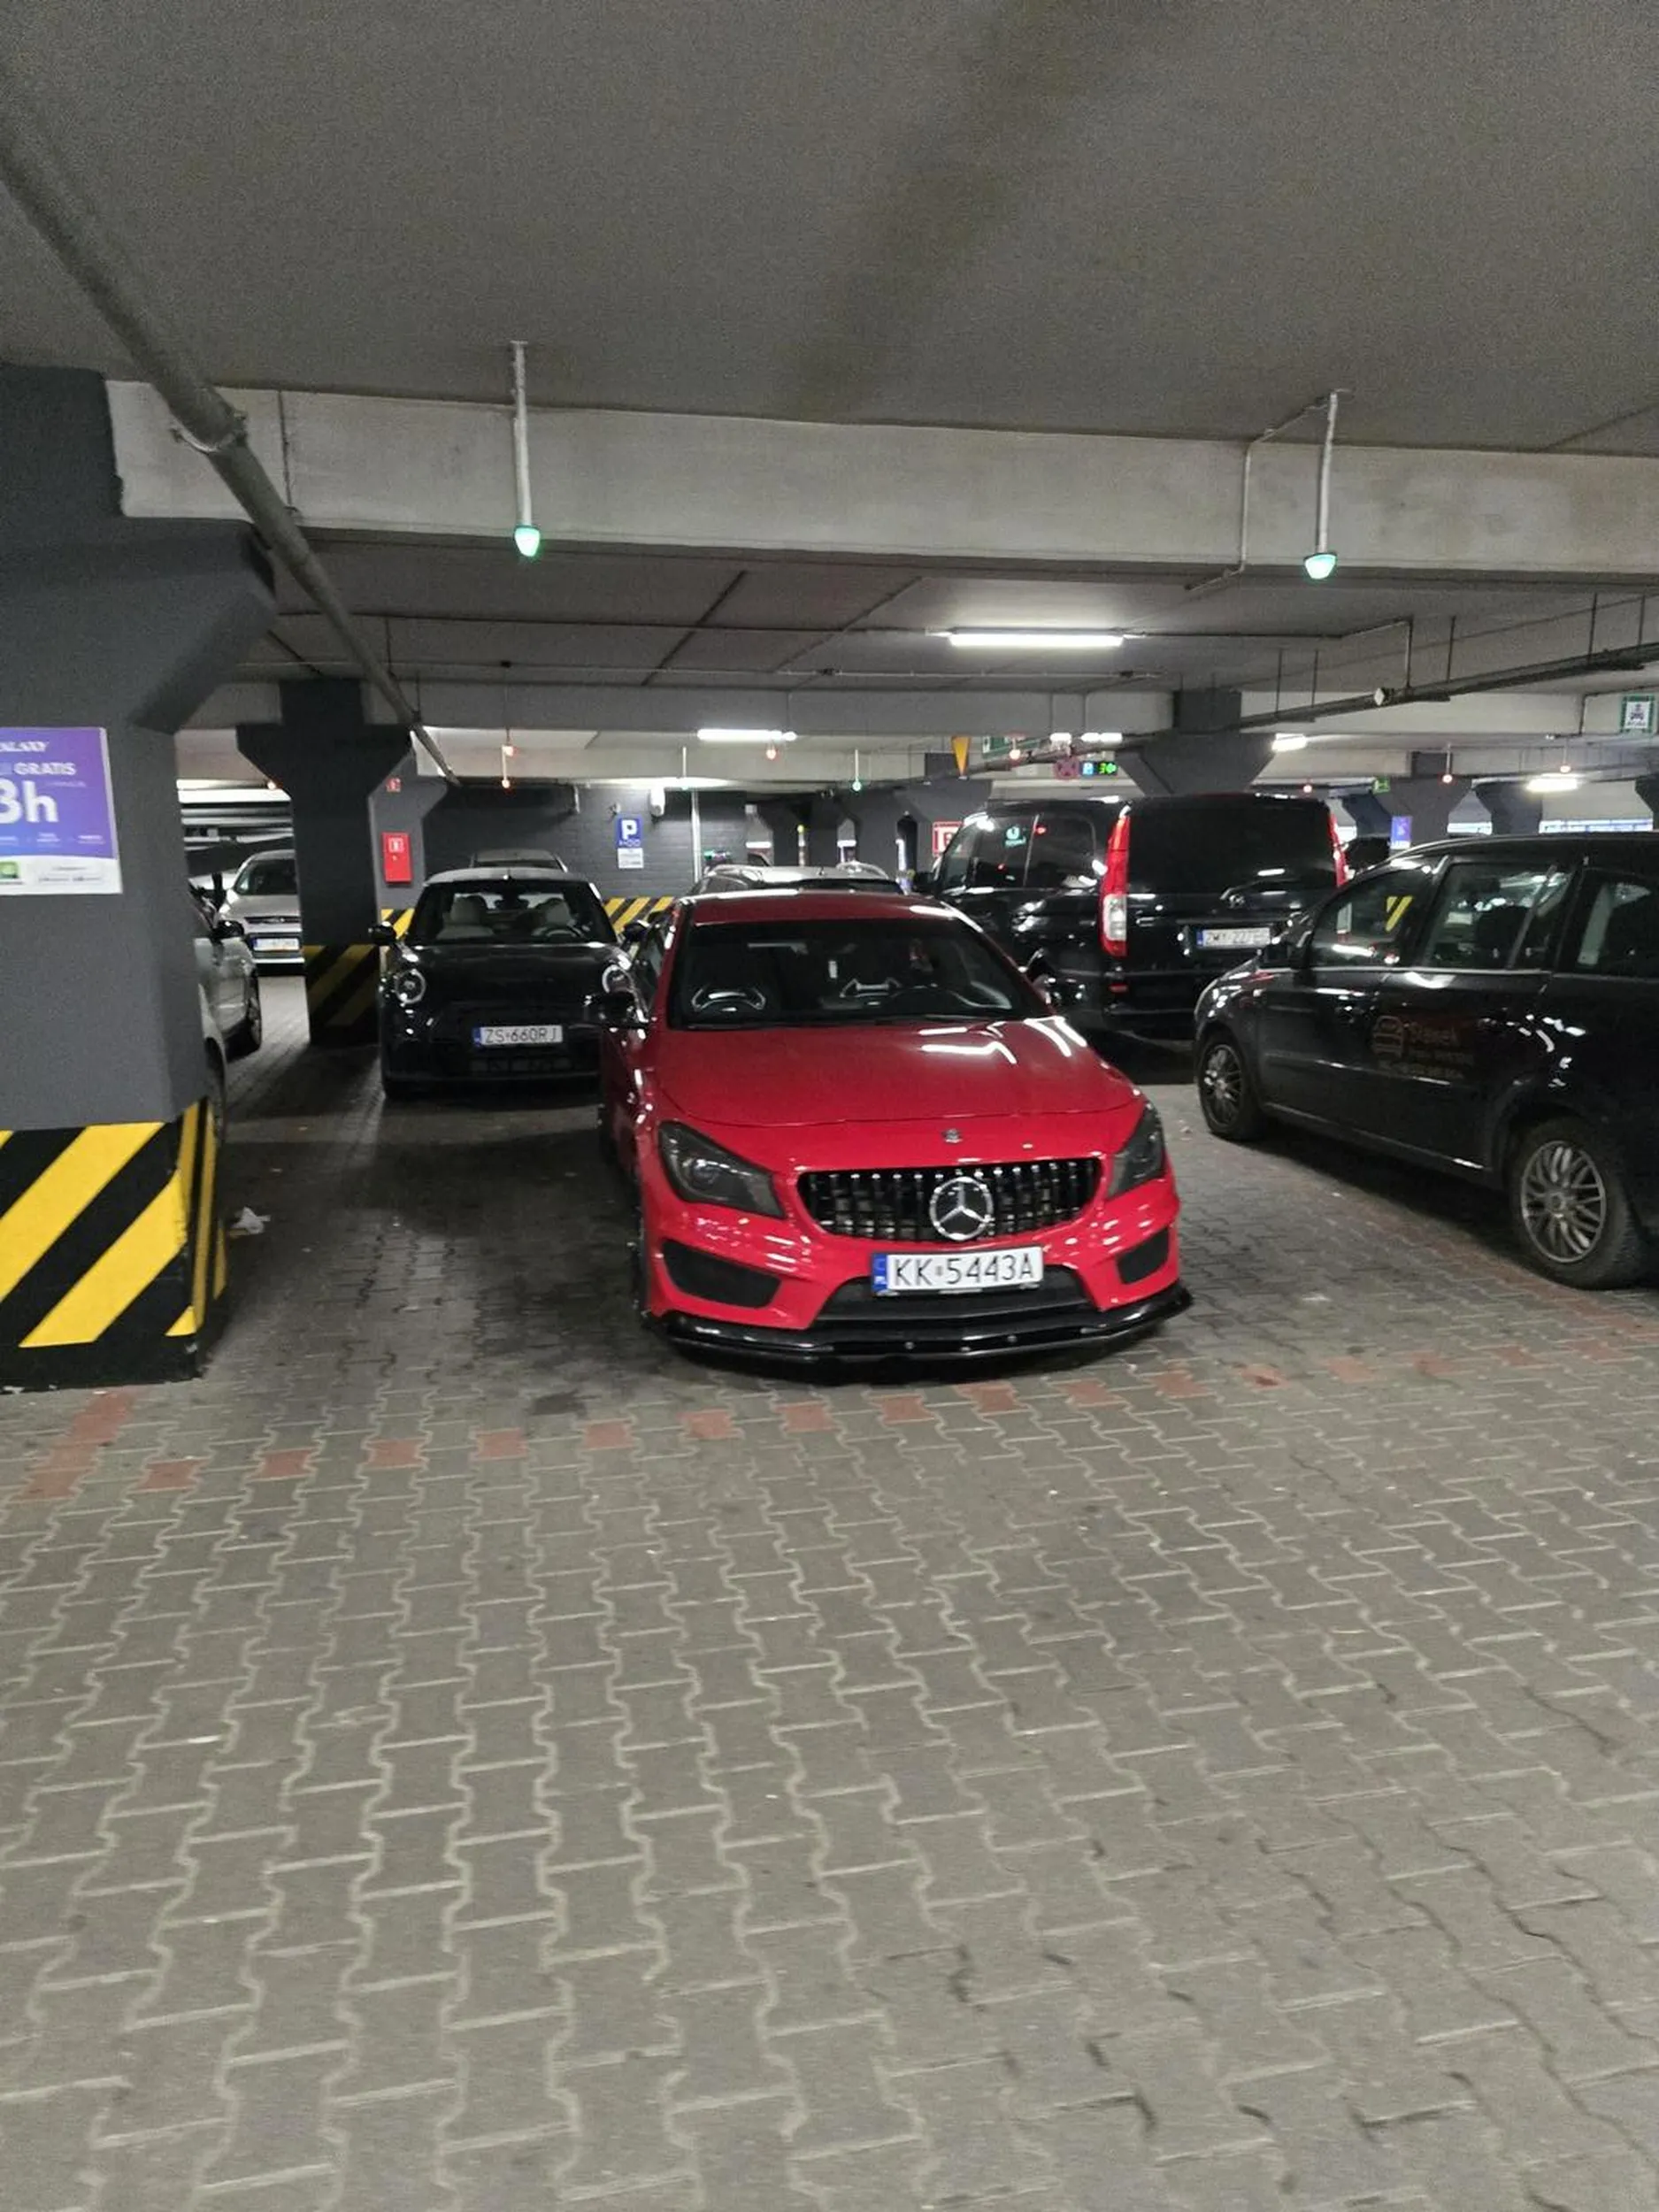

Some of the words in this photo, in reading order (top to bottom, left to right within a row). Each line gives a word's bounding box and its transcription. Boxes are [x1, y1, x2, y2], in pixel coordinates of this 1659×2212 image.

[13, 762, 76, 775] GRATIS
[621, 819, 637, 840] P
[485, 1029, 504, 1043] ZS
[895, 1257, 932, 1286] KK
[947, 1253, 1033, 1284] 5443A
